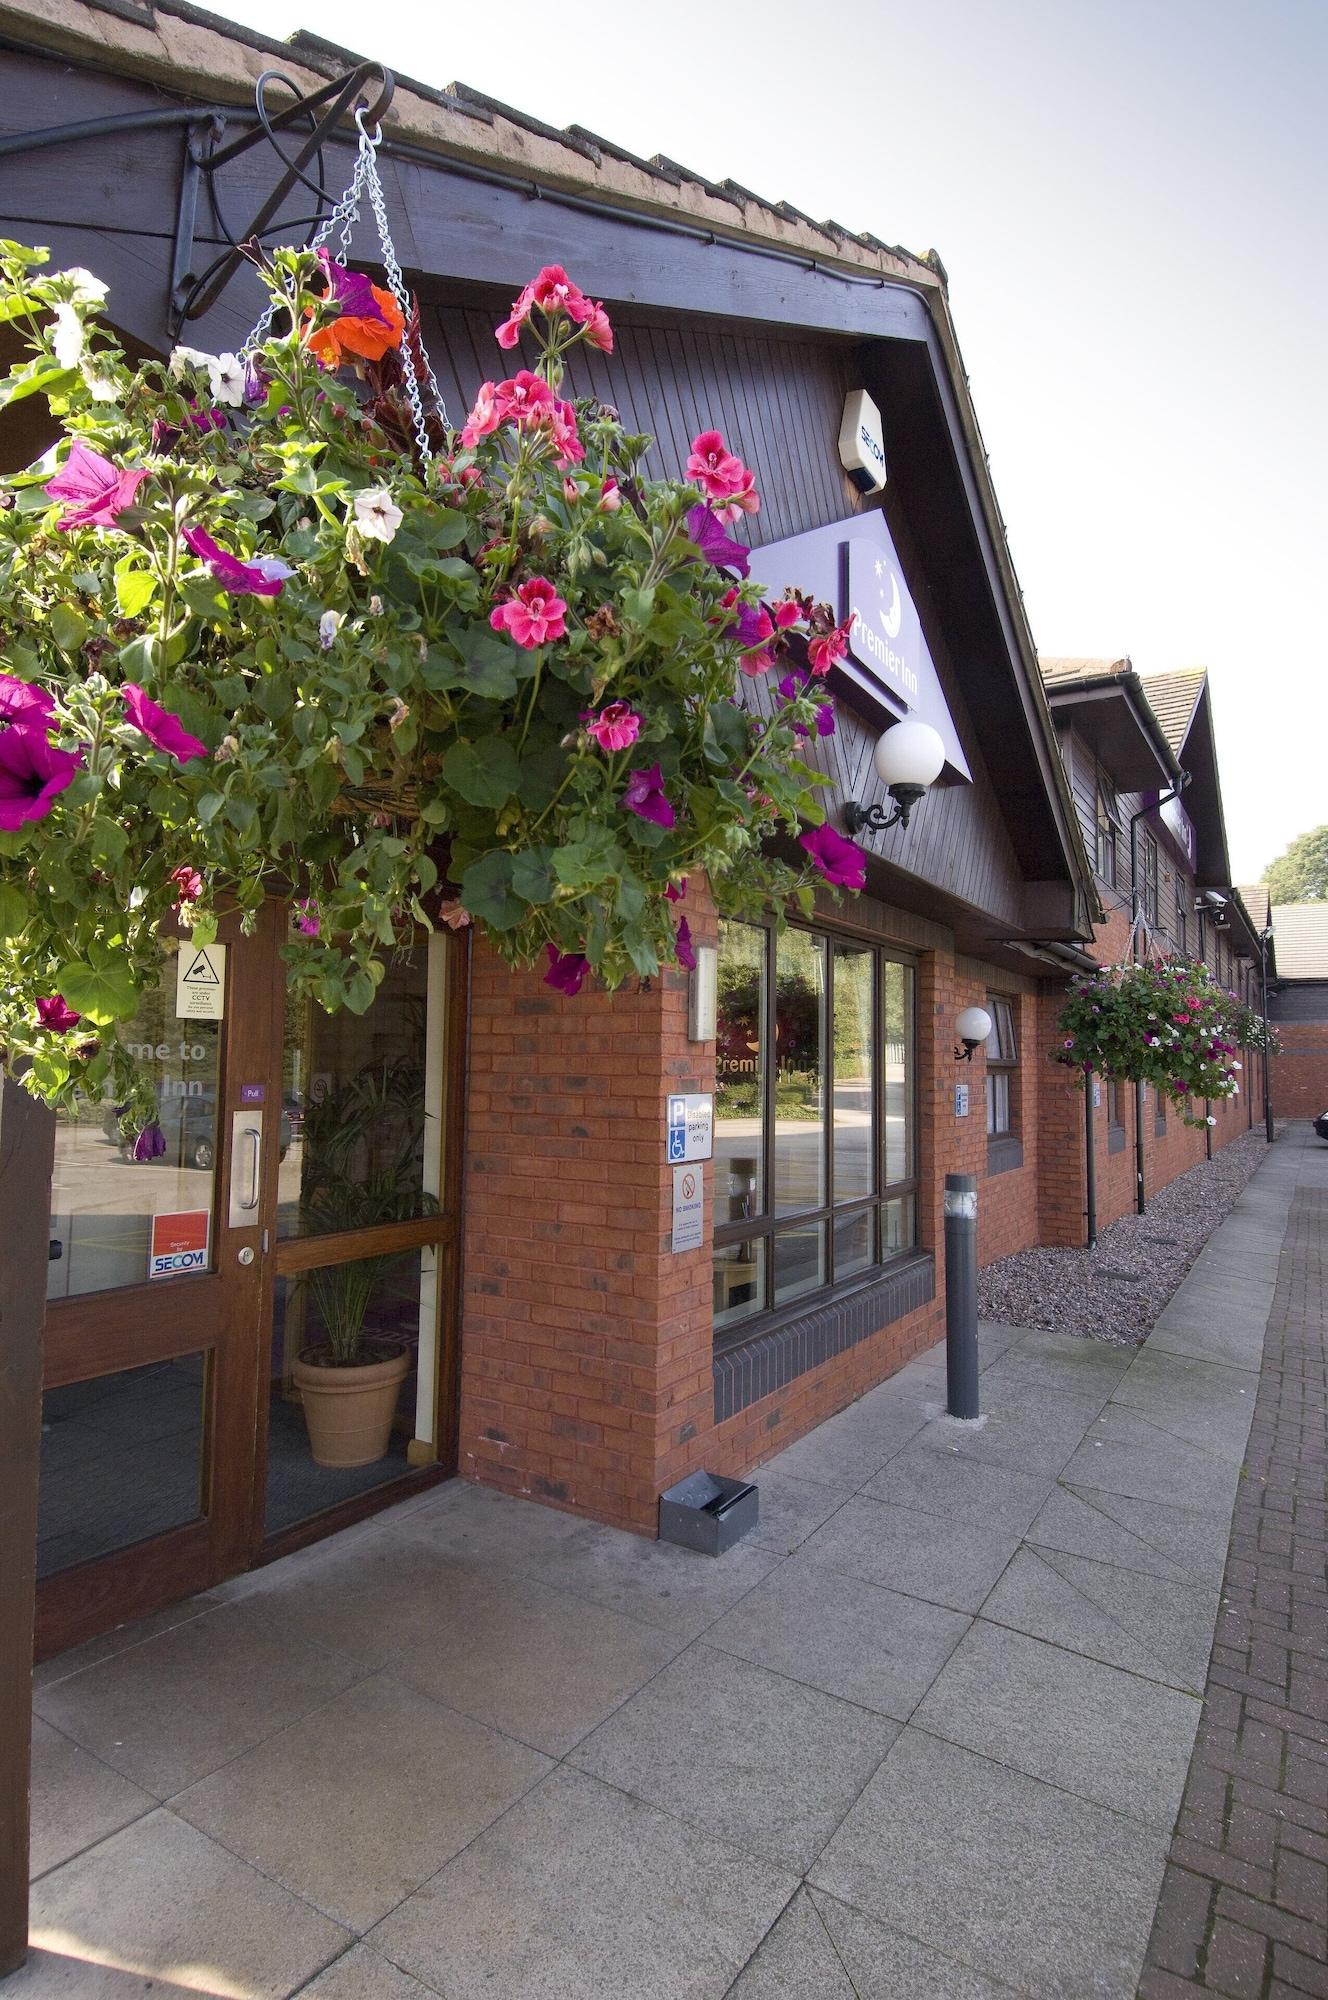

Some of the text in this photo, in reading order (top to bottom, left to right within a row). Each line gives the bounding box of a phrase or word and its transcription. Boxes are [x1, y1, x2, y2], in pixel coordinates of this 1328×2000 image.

[853, 606, 917, 697] Premier Inn
[179, 1041, 206, 1061] to
[163, 1074, 203, 1097] Inn
[247, 1089, 259, 1097] Pull
[673, 1101, 684, 1127] P
[688, 1121, 709, 1133] parking
[692, 1134, 704, 1144] only
[155, 1252, 204, 1271] SECOM
